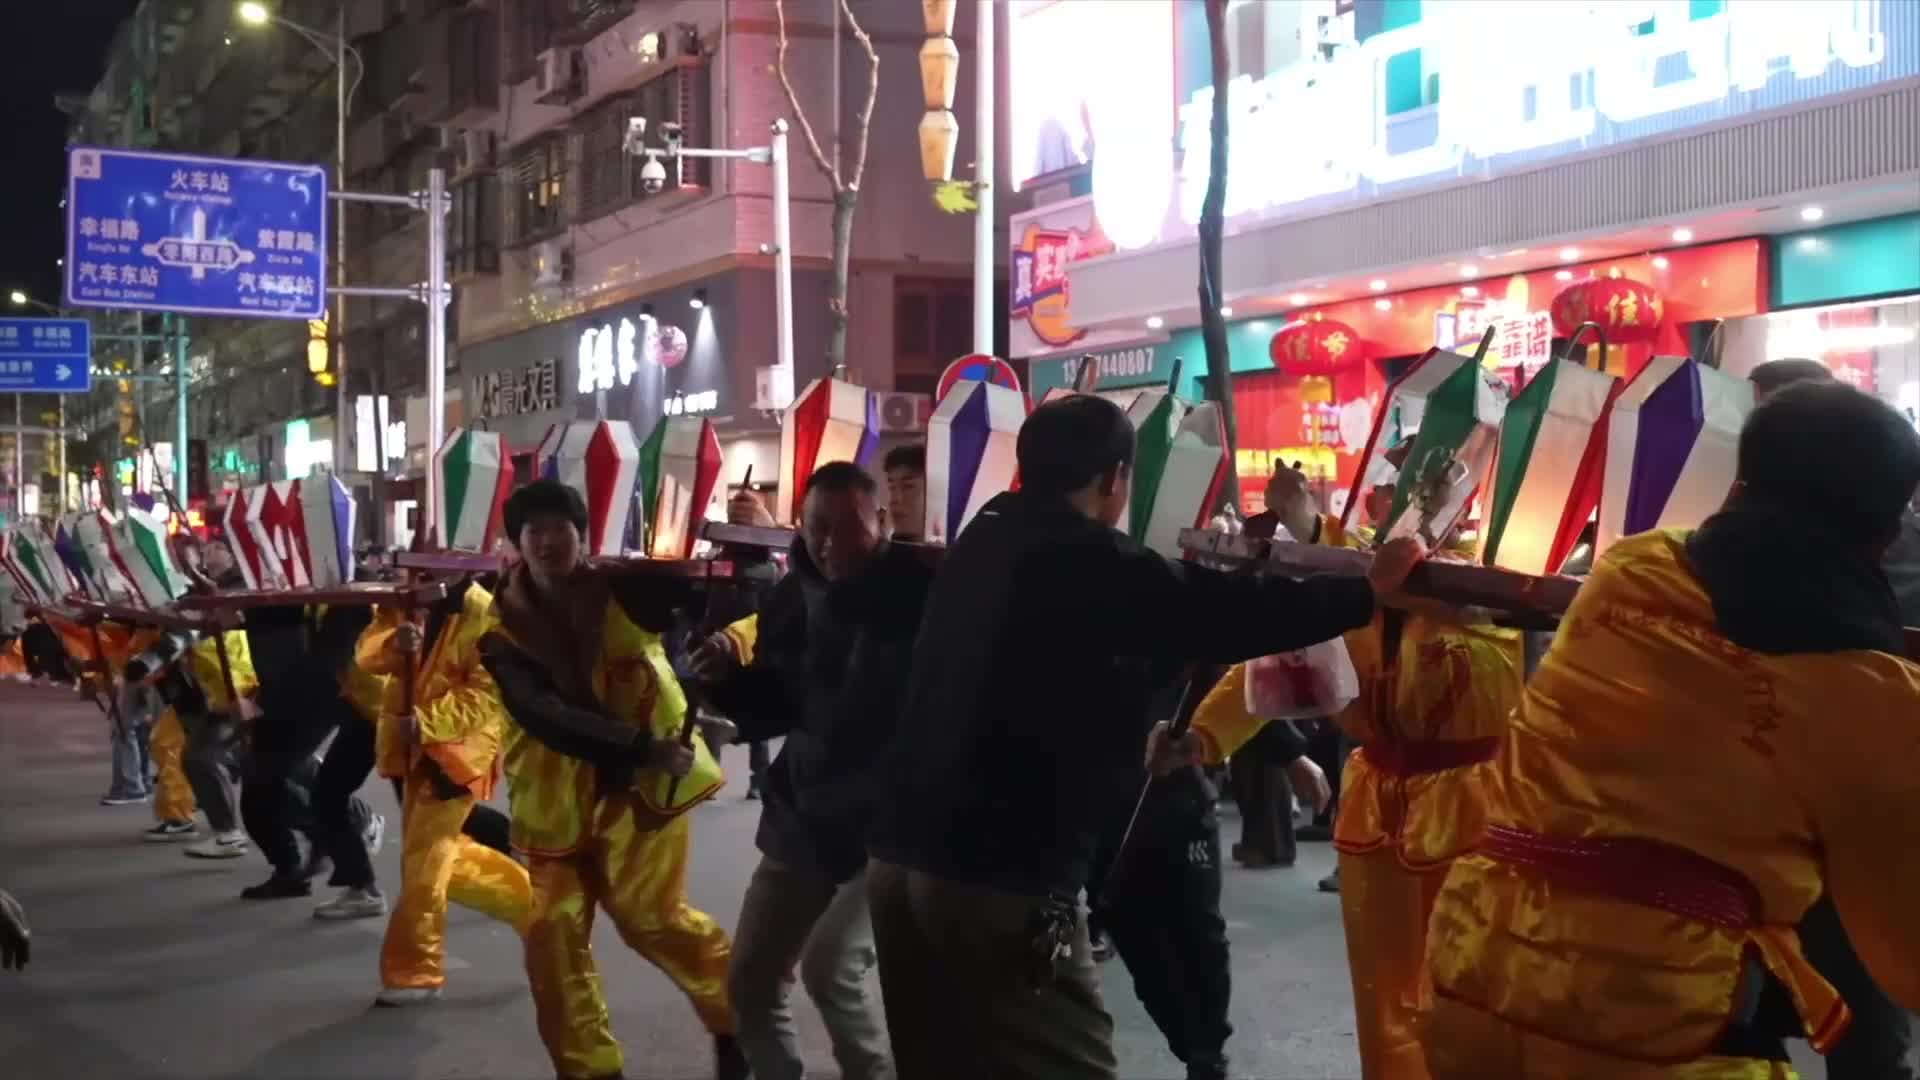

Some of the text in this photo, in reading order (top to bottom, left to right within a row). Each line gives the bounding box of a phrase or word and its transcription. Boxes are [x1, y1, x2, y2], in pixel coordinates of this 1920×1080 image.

[170, 169, 230, 192] 火车站
[79, 217, 140, 241] 幸福路
[78, 261, 159, 287] 汽车东站
[237, 271, 315, 296] 汽车西站
